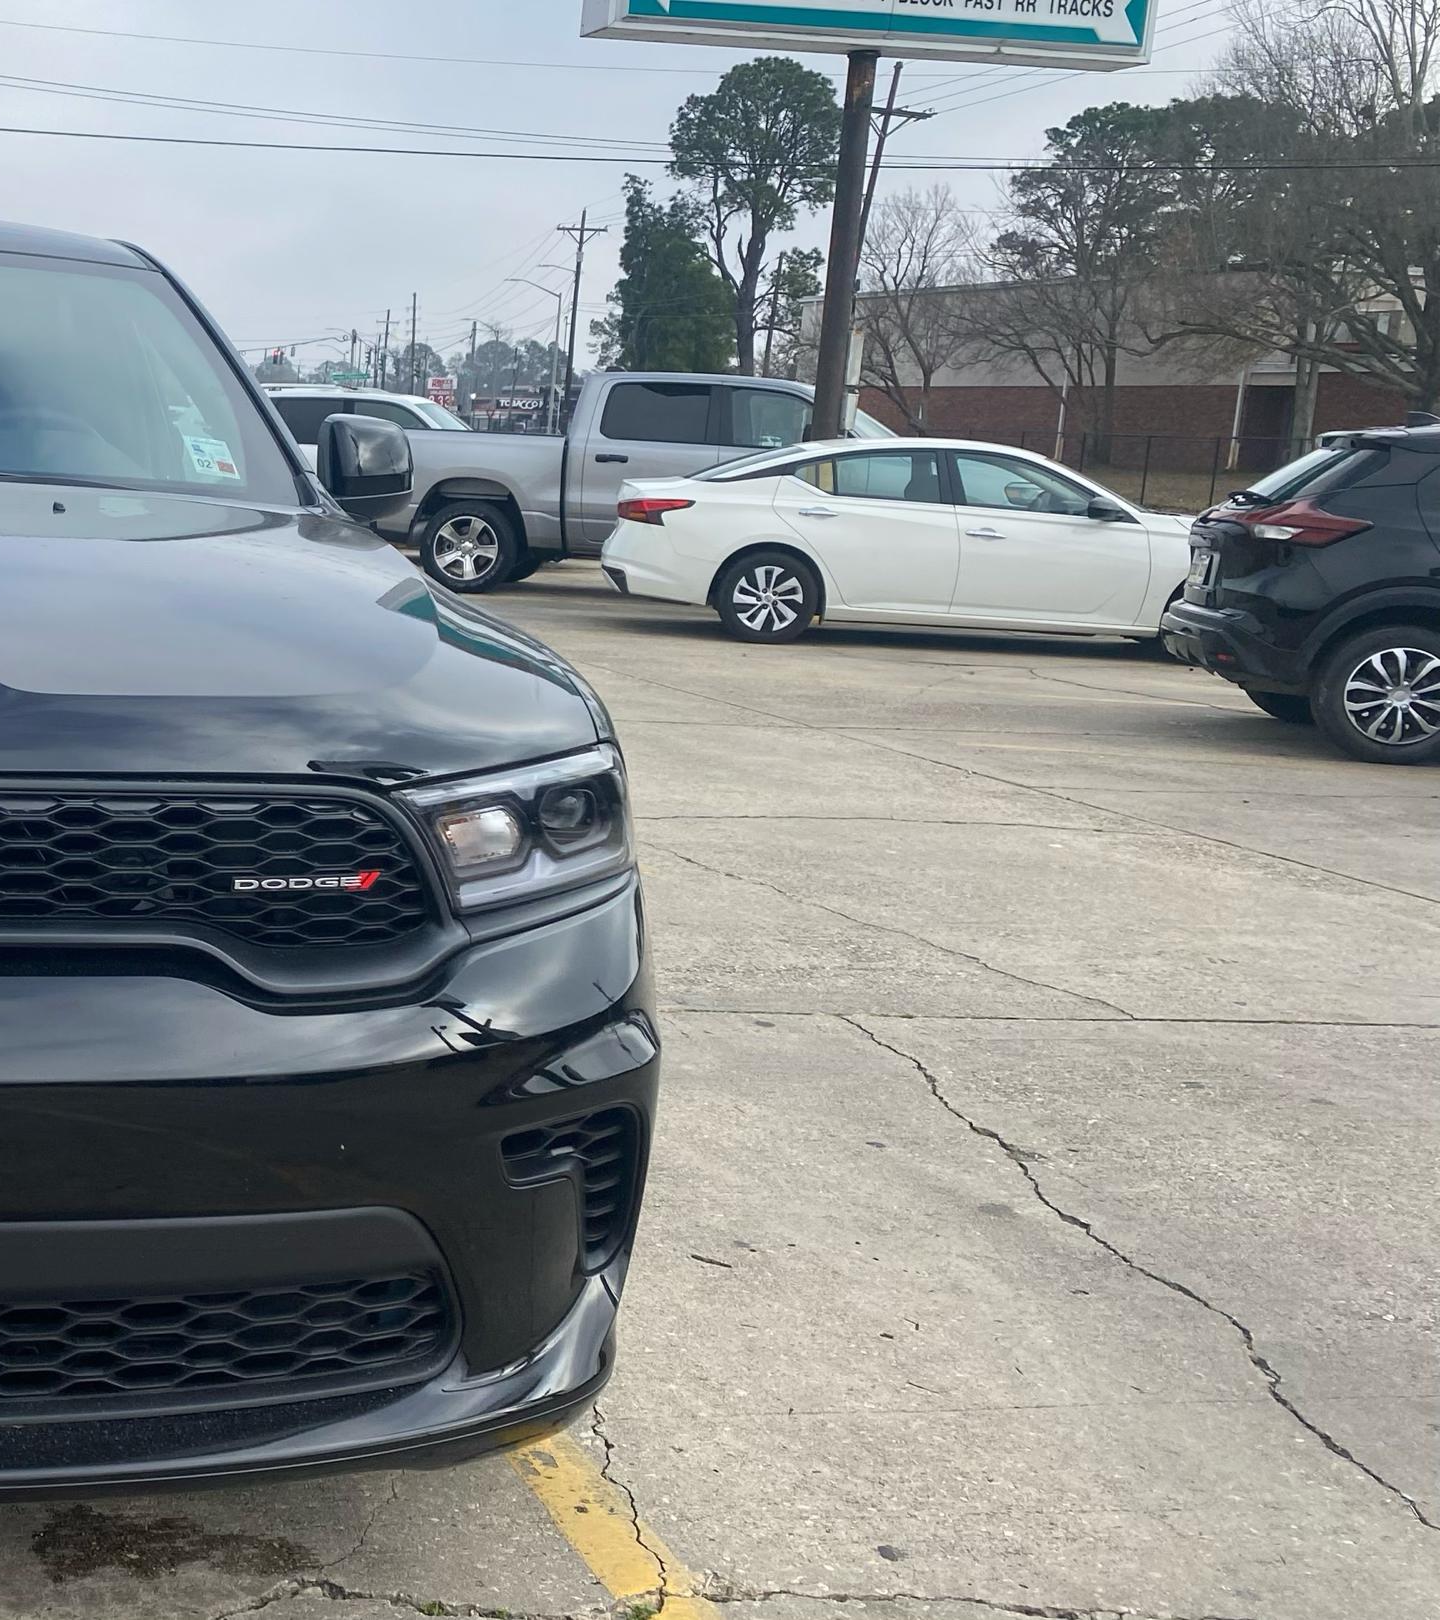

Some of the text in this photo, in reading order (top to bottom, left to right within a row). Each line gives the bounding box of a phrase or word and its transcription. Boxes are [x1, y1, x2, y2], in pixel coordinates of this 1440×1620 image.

[1015, 0, 1036, 12] RR
[1050, 0, 1114, 17] TRACKS
[197, 458, 213, 469] 02
[234, 876, 362, 890] DODGE
